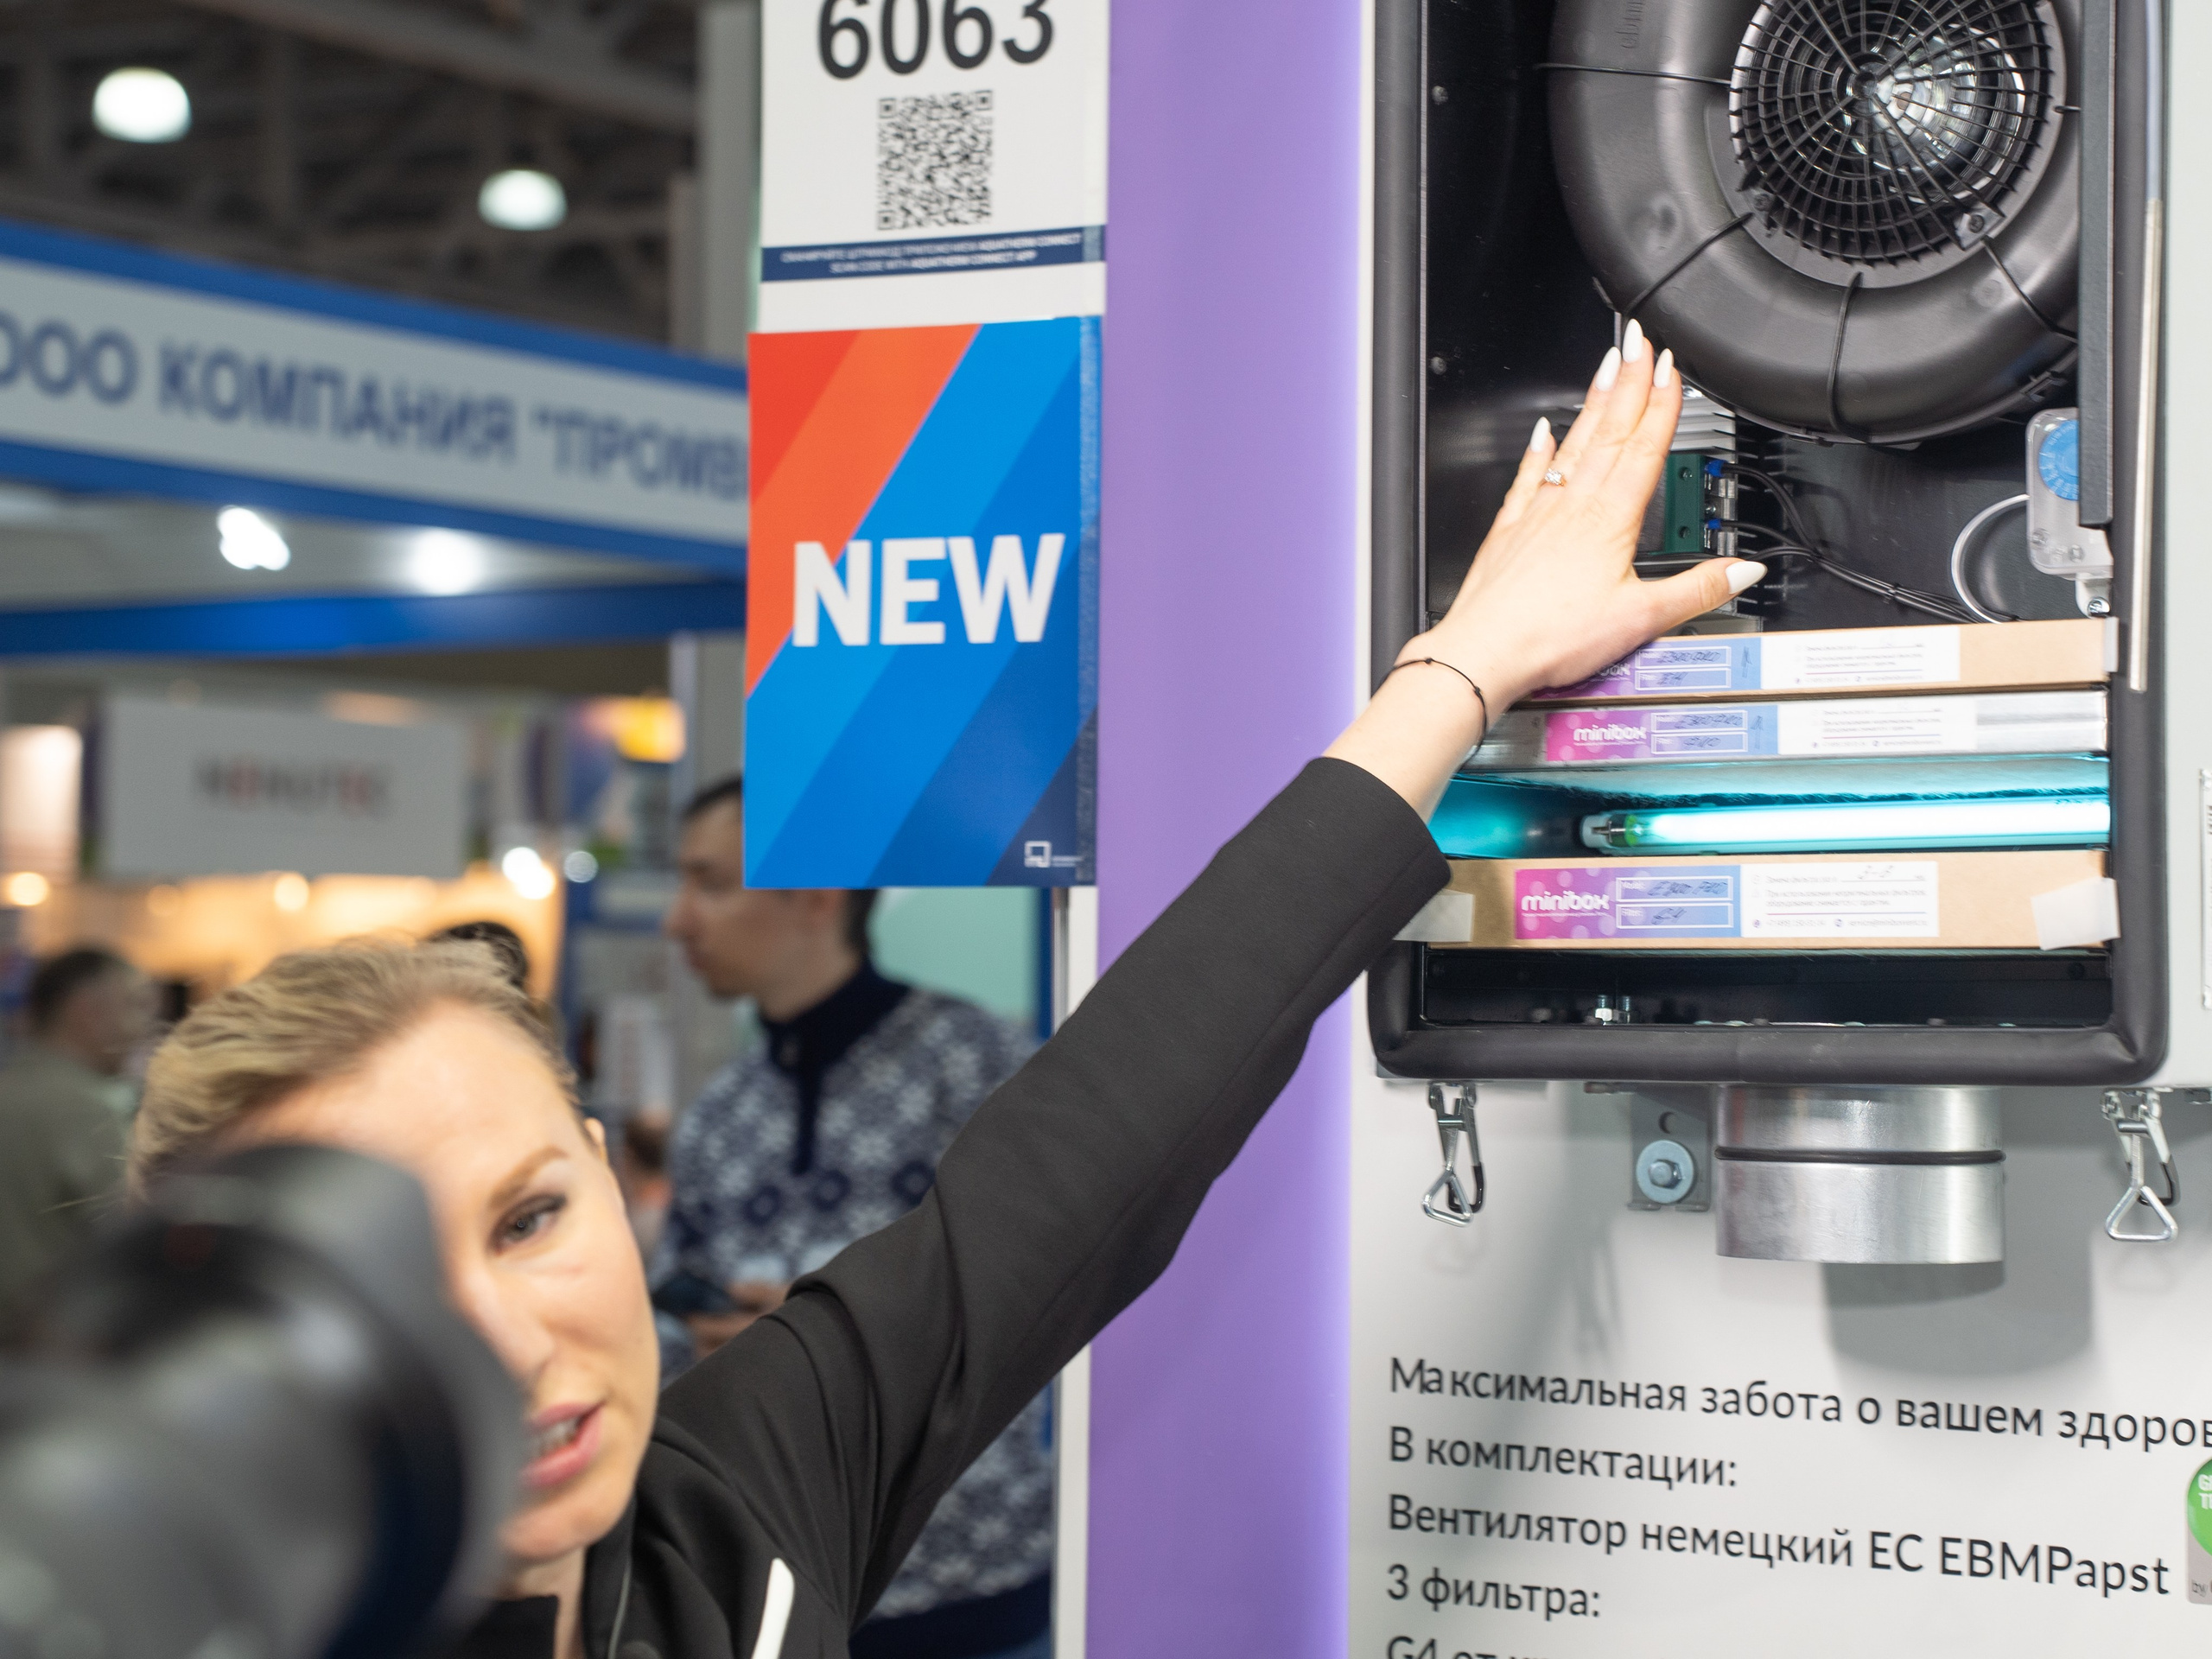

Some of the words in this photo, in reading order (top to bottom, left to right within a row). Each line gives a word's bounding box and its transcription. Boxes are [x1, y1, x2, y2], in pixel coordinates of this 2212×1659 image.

[817, 0, 1053, 80] 6063
[159, 342, 517, 467] КОМПАНИЯ
[792, 532, 1066, 647] NEW
[1573, 723, 1647, 741] minibox
[1521, 890, 1611, 911] minibox
[1389, 1357, 1688, 1412] Максимальная
[1700, 1380, 1842, 1423] забота
[1858, 1396, 1881, 1425] о
[1897, 1398, 2043, 1437] вашем
[1389, 1426, 1414, 1462] В
[1427, 1437, 1738, 1490] комплектации:
[1389, 1493, 1627, 1554] Вентилятор
[1641, 1522, 1853, 1566] немецкий
[1939, 1535, 2171, 1598] EBMPapst
[1386, 1563, 1410, 1601] 3
[1421, 1567, 1601, 1622] фильтра:
